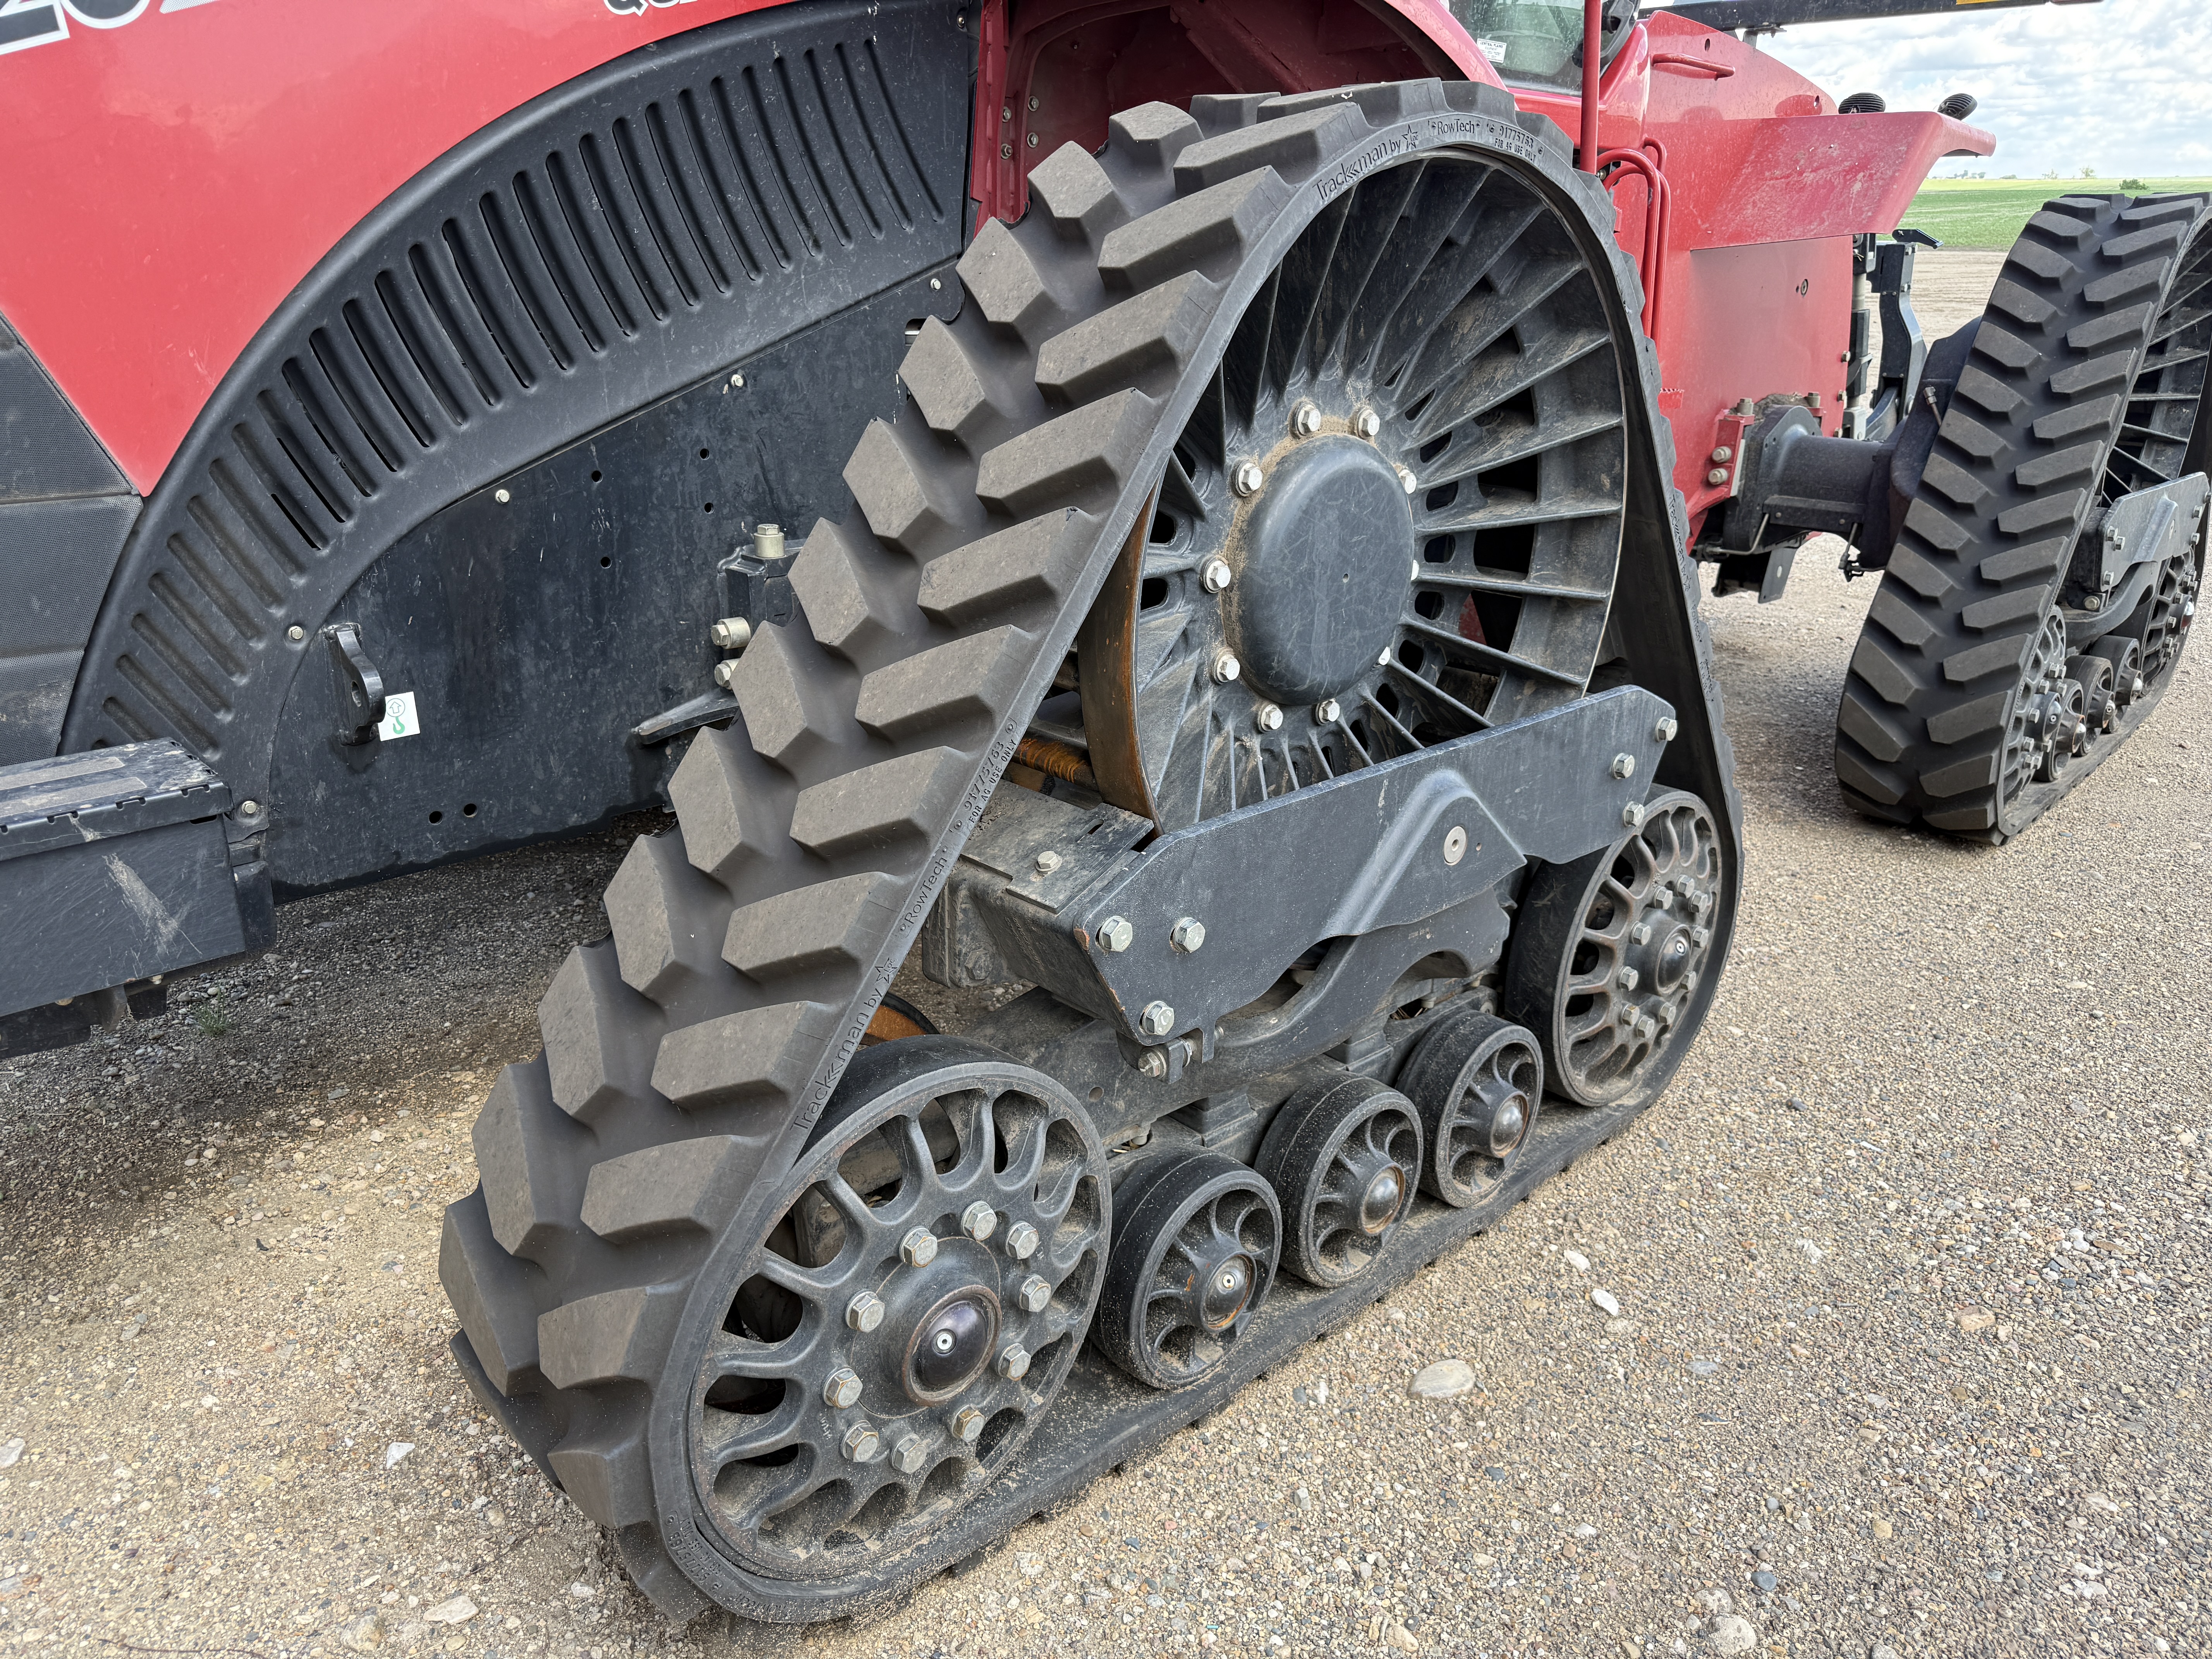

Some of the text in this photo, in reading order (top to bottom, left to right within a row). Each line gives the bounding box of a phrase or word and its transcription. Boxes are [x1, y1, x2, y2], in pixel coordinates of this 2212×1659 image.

[1437, 118, 1475, 135] RowTech
[1389, 139, 1401, 154] by
[1494, 137, 1503, 148] FOR
[1514, 144, 1523, 154] USE
[1525, 151, 1536, 163] ONLY
[964, 741, 1004, 811] 91775763
[969, 738, 1017, 823] FOR AG USE ONLY
[904, 857, 948, 924] RowTech
[864, 988, 883, 1008] by
